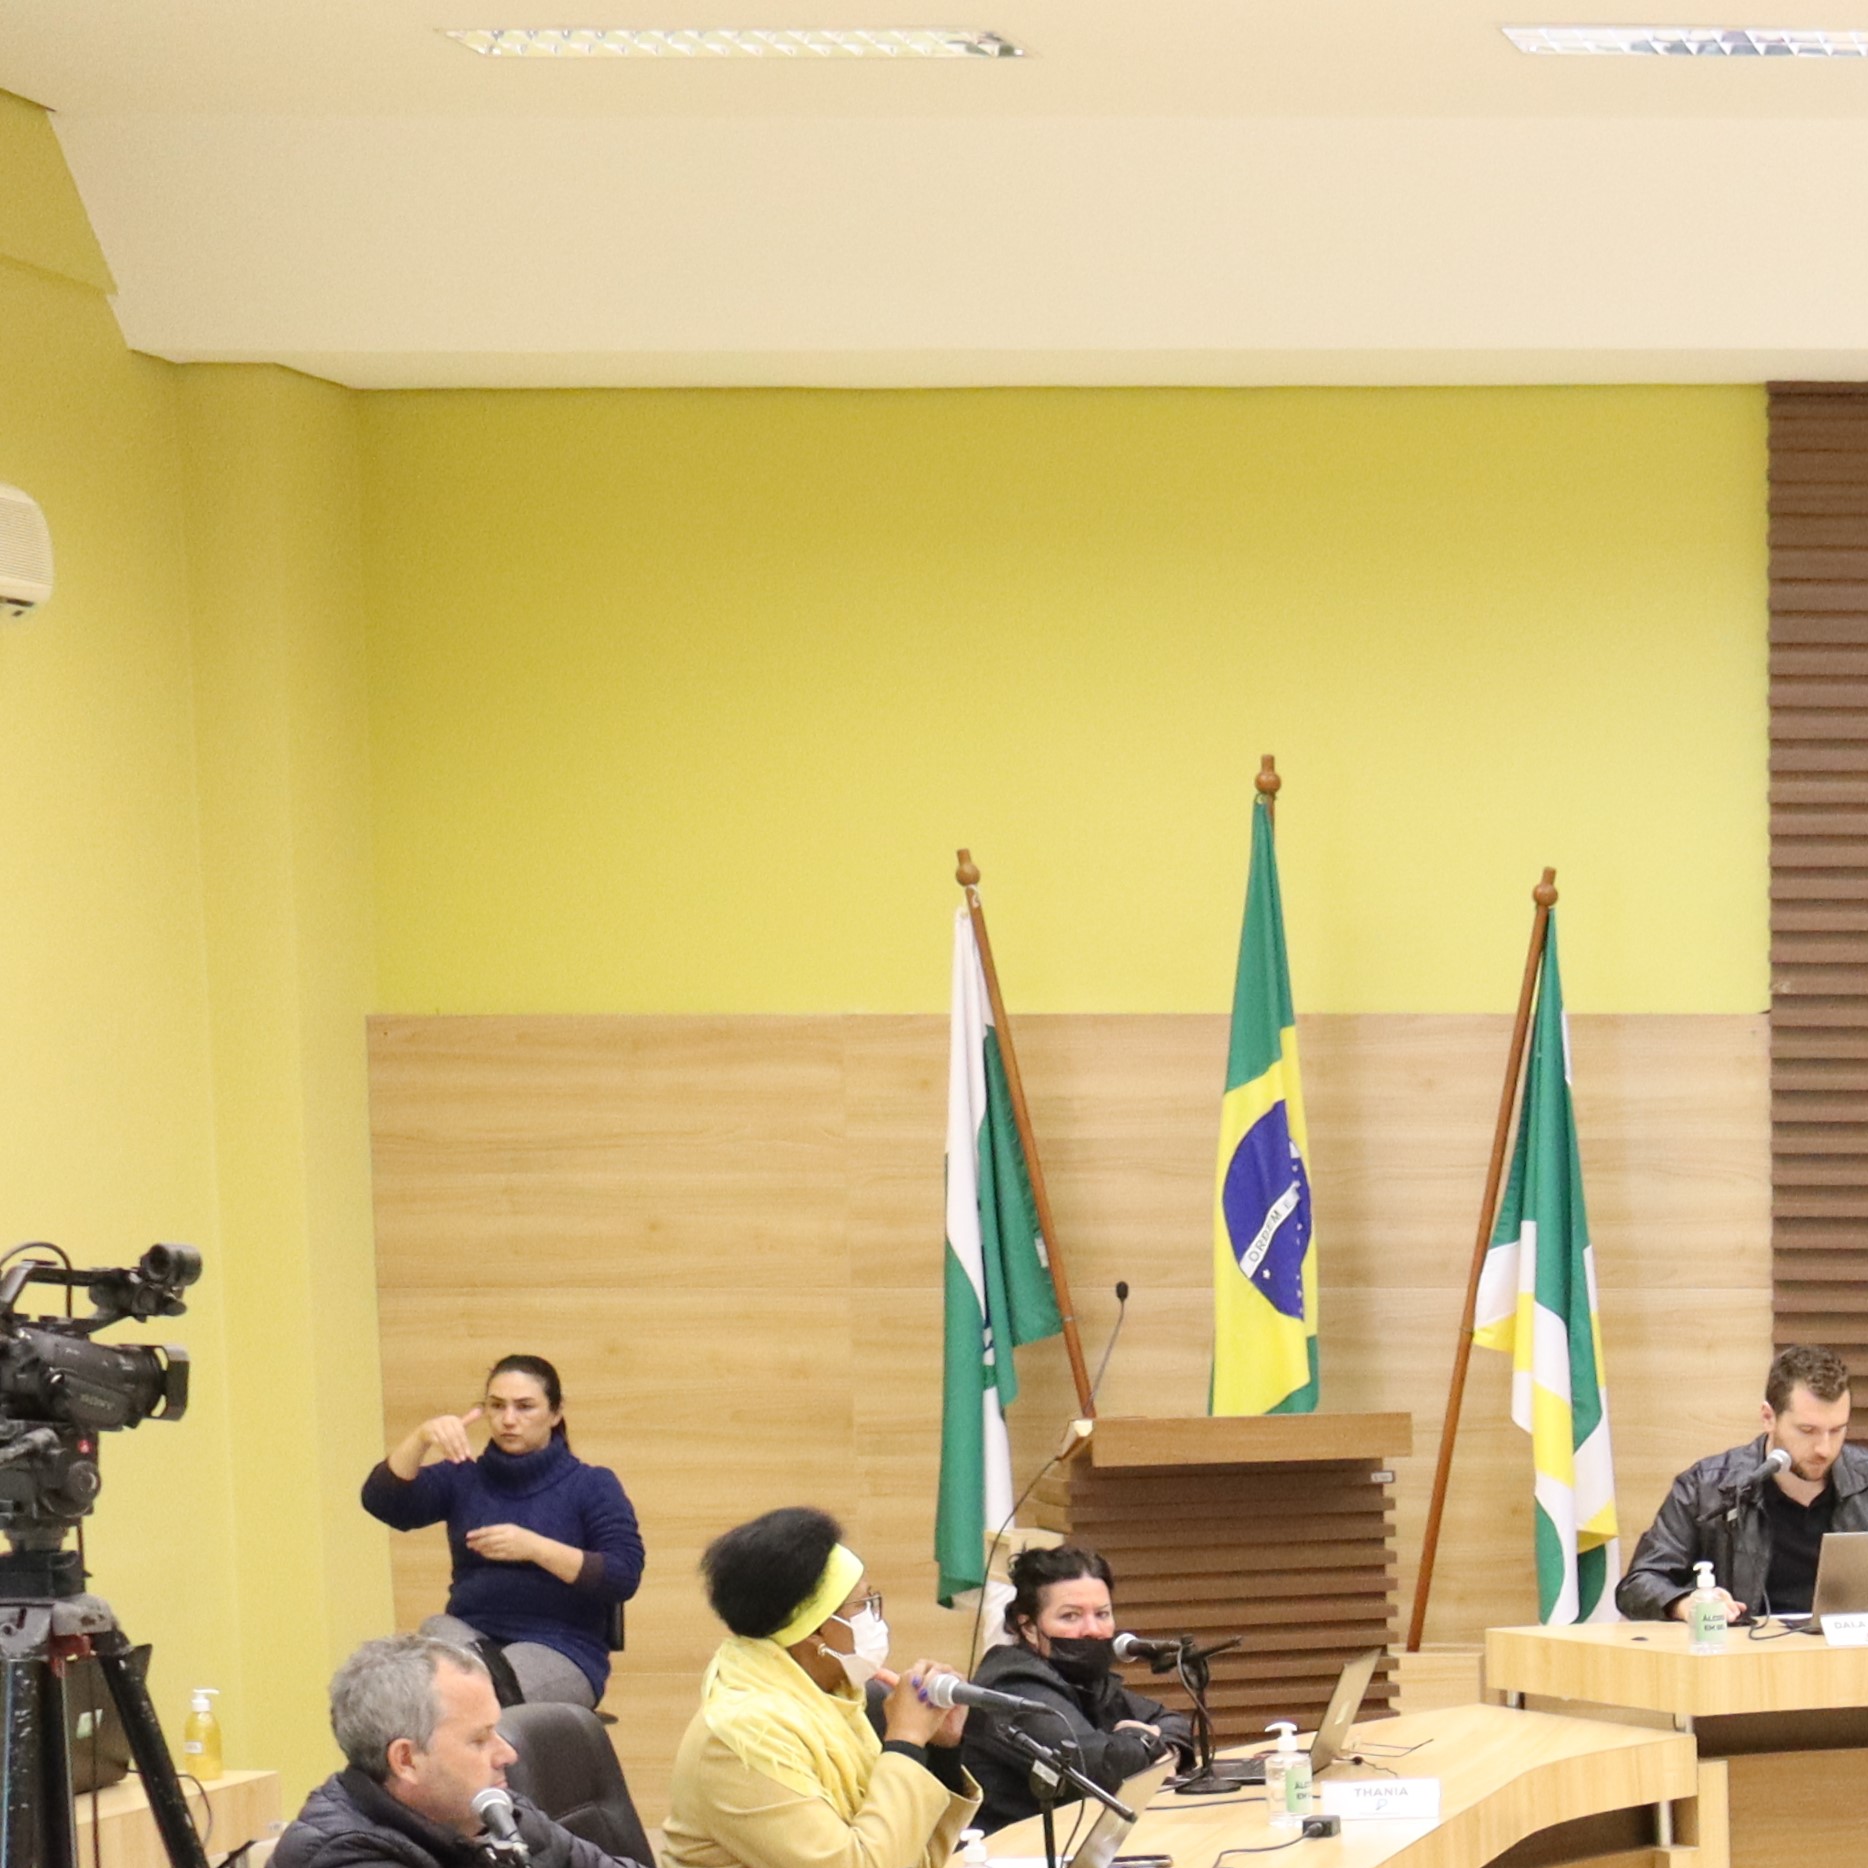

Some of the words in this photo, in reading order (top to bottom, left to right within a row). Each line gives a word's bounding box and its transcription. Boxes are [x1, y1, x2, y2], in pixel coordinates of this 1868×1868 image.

[1248, 1209, 1281, 1262] ORDEM
[1834, 1619, 1866, 1629] DALA
[1354, 1786, 1409, 1798] THANIA
